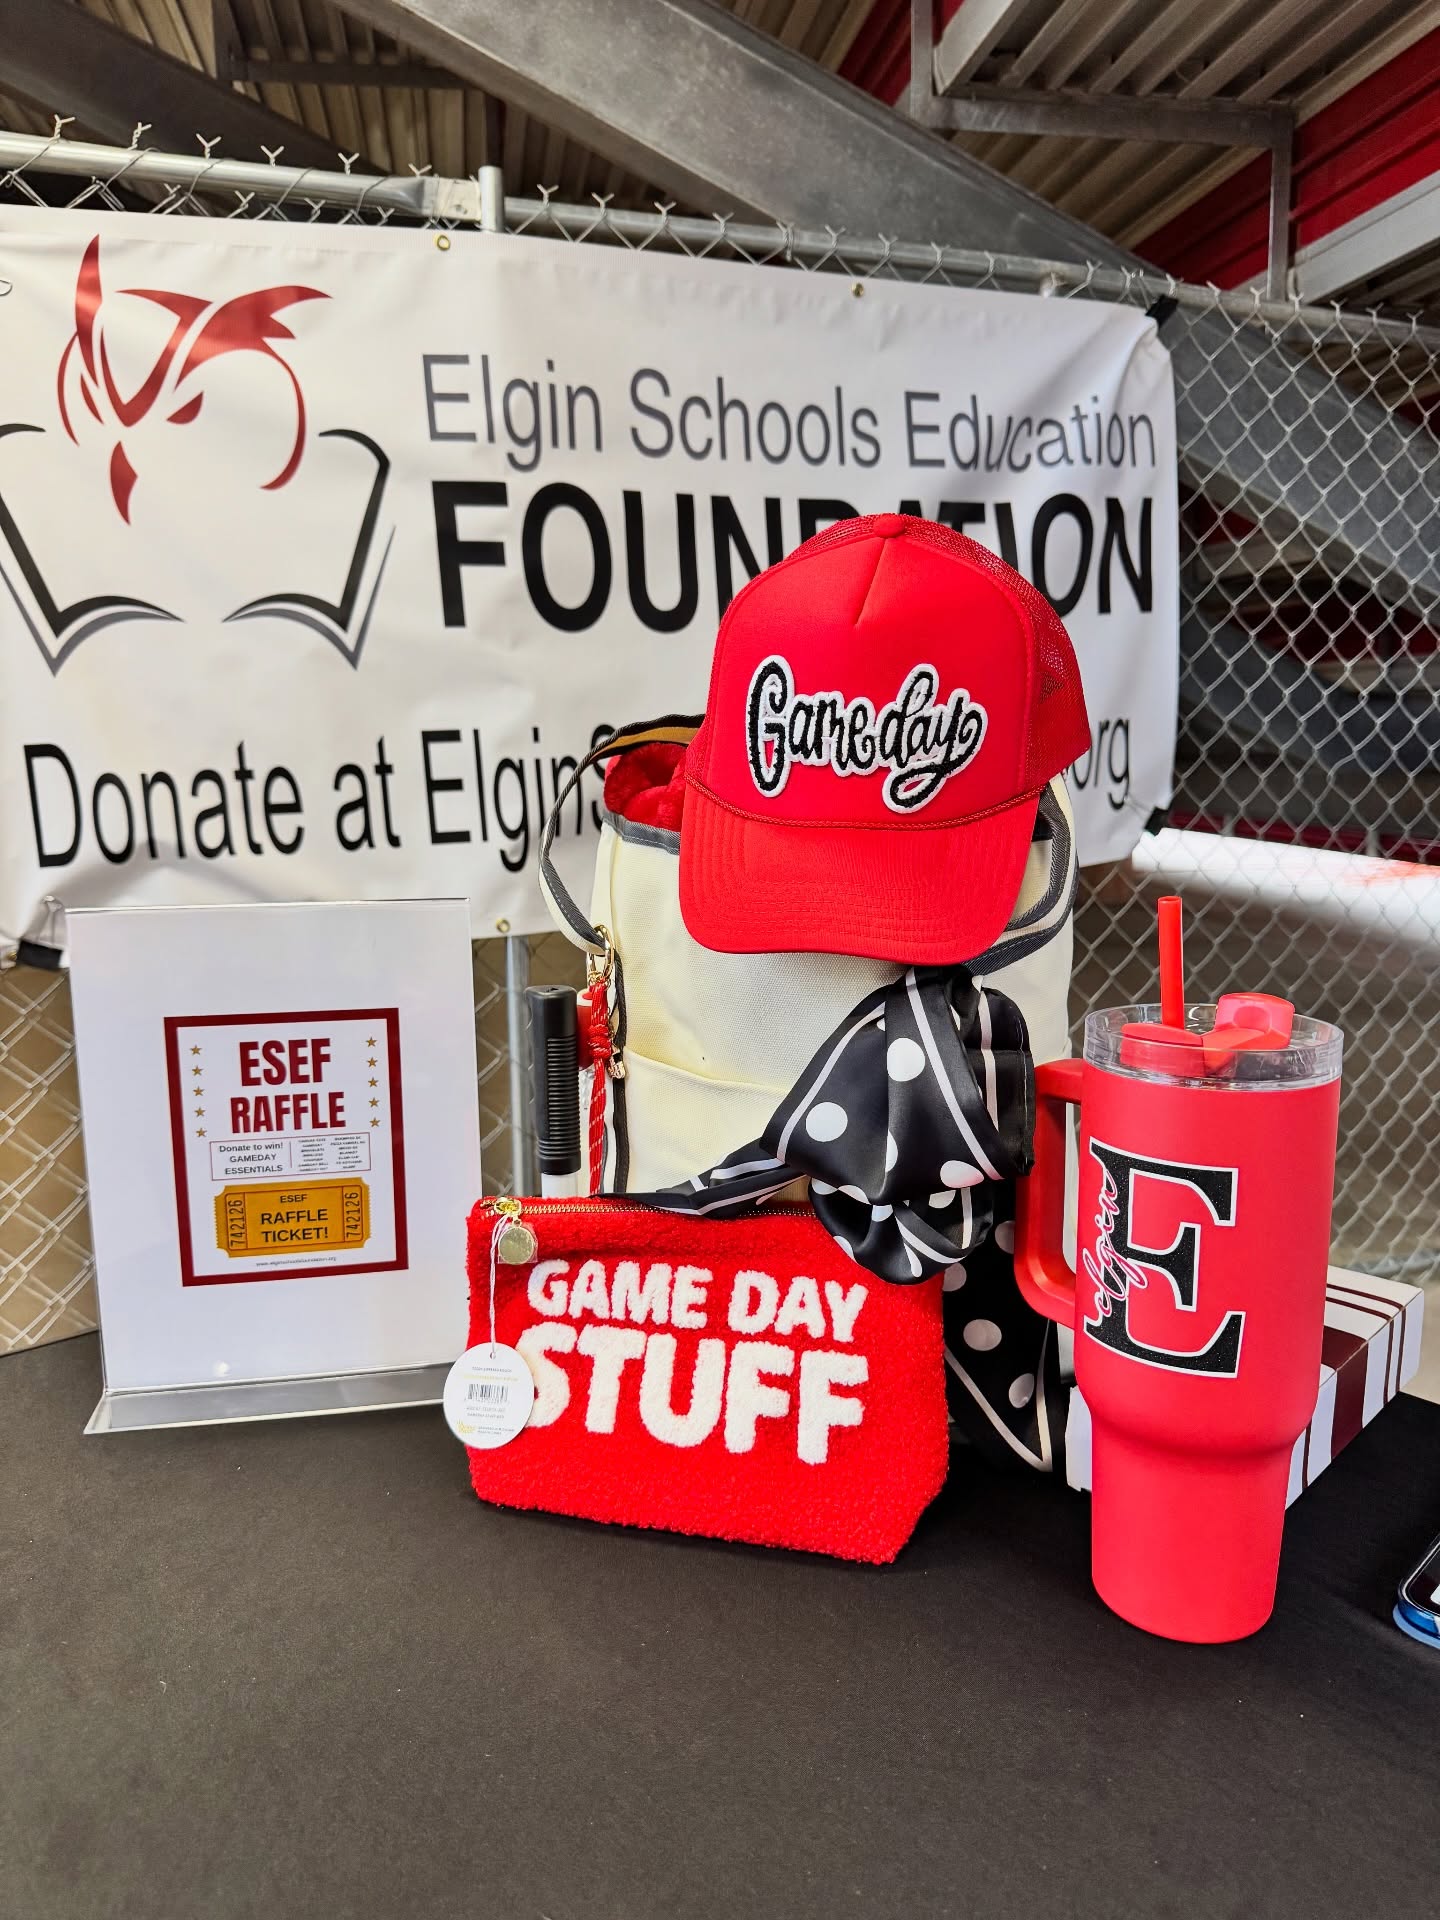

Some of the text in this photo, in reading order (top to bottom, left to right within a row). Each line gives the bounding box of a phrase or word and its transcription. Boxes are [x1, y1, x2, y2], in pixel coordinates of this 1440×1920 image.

[422, 353, 1157, 472] Elgin Schools Education
[431, 480, 1153, 633] FOUNION
[747, 657, 986, 811] Gameday
[23, 742, 304, 868] Donate
[334, 737, 402, 851] at
[239, 1038, 332, 1087] ESEF
[230, 1092, 346, 1134] RAFFLE
[219, 1145, 251, 1153] Donate
[264, 1142, 284, 1150] win!
[225, 1164, 283, 1175] ESSENTIALS
[229, 1153, 277, 1163] GAMEDAY
[261, 1208, 329, 1225] RAFFLE
[280, 1193, 308, 1203] ESEF
[344, 1191, 361, 1238] 742126
[227, 1199, 245, 1247] 742126
[261, 1227, 329, 1243] TICKET!
[1084, 1136, 1246, 1378] E
[527, 1259, 869, 1343] GAME DAY
[514, 1321, 869, 1466] STUFF
